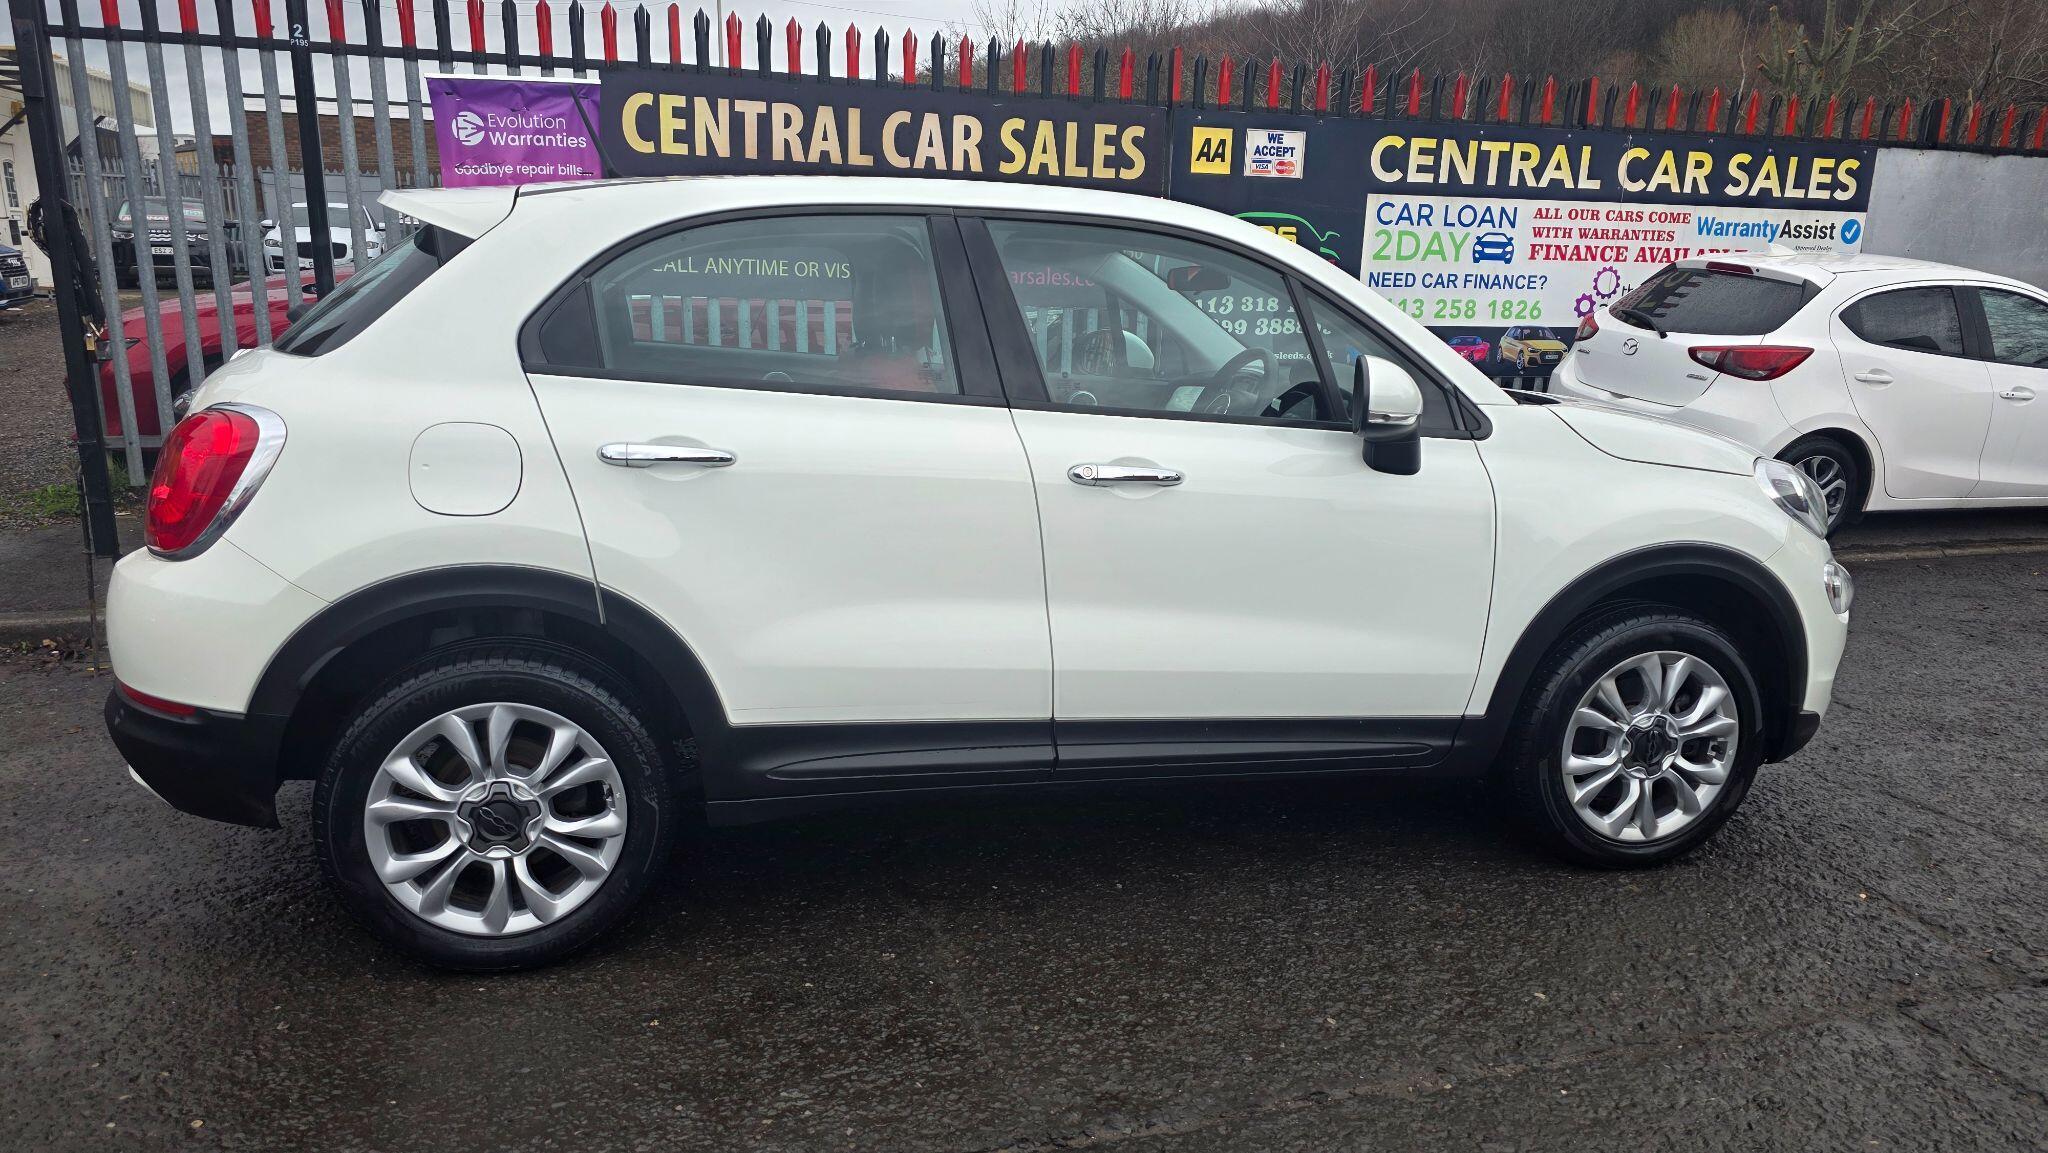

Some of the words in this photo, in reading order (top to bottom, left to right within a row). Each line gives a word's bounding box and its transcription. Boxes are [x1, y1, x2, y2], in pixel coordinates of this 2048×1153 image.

[293, 24, 303, 37] 2
[290, 39, 309, 47] P195
[487, 113, 566, 129] Evolution
[488, 131, 587, 148] Warranties
[621, 92, 874, 166] CENTRAL
[882, 111, 983, 172] CAR
[998, 117, 1146, 180] SALES
[1268, 132, 1284, 144] WE
[1195, 138, 1227, 162] AA
[1253, 145, 1296, 157] ACCEPT
[454, 162, 513, 177] Goodbye
[516, 164, 555, 177] repair
[1370, 135, 1601, 190] CENTRAL
[1617, 147, 1713, 194] CAR
[1723, 153, 1861, 201] SALES
[1376, 201, 1434, 226] CAR
[1443, 204, 1518, 228] LOAN
[1533, 207, 1563, 219] ALL
[1567, 209, 1601, 221] OUR
[1605, 210, 1644, 223] CARS
[1648, 211, 1692, 224] COME
[1532, 226, 1574, 239] WITH
[1578, 227, 1675, 242] WARRANTIES
[1372, 229, 1471, 262] 2DAY
[1528, 244, 1629, 263] FINANCE
[652, 256, 698, 273] ALL
[704, 257, 789, 276] ANYTIME
[794, 261, 819, 278] OR
[1368, 271, 1417, 288] NEED
[1421, 273, 1458, 289] CAR
[1463, 274, 1548, 290] FINANCE?
[1241, 296, 1279, 312] 318
[1388, 298, 1425, 319] 13
[1433, 299, 1477, 319] 258
[1488, 300, 1542, 320] 1826
